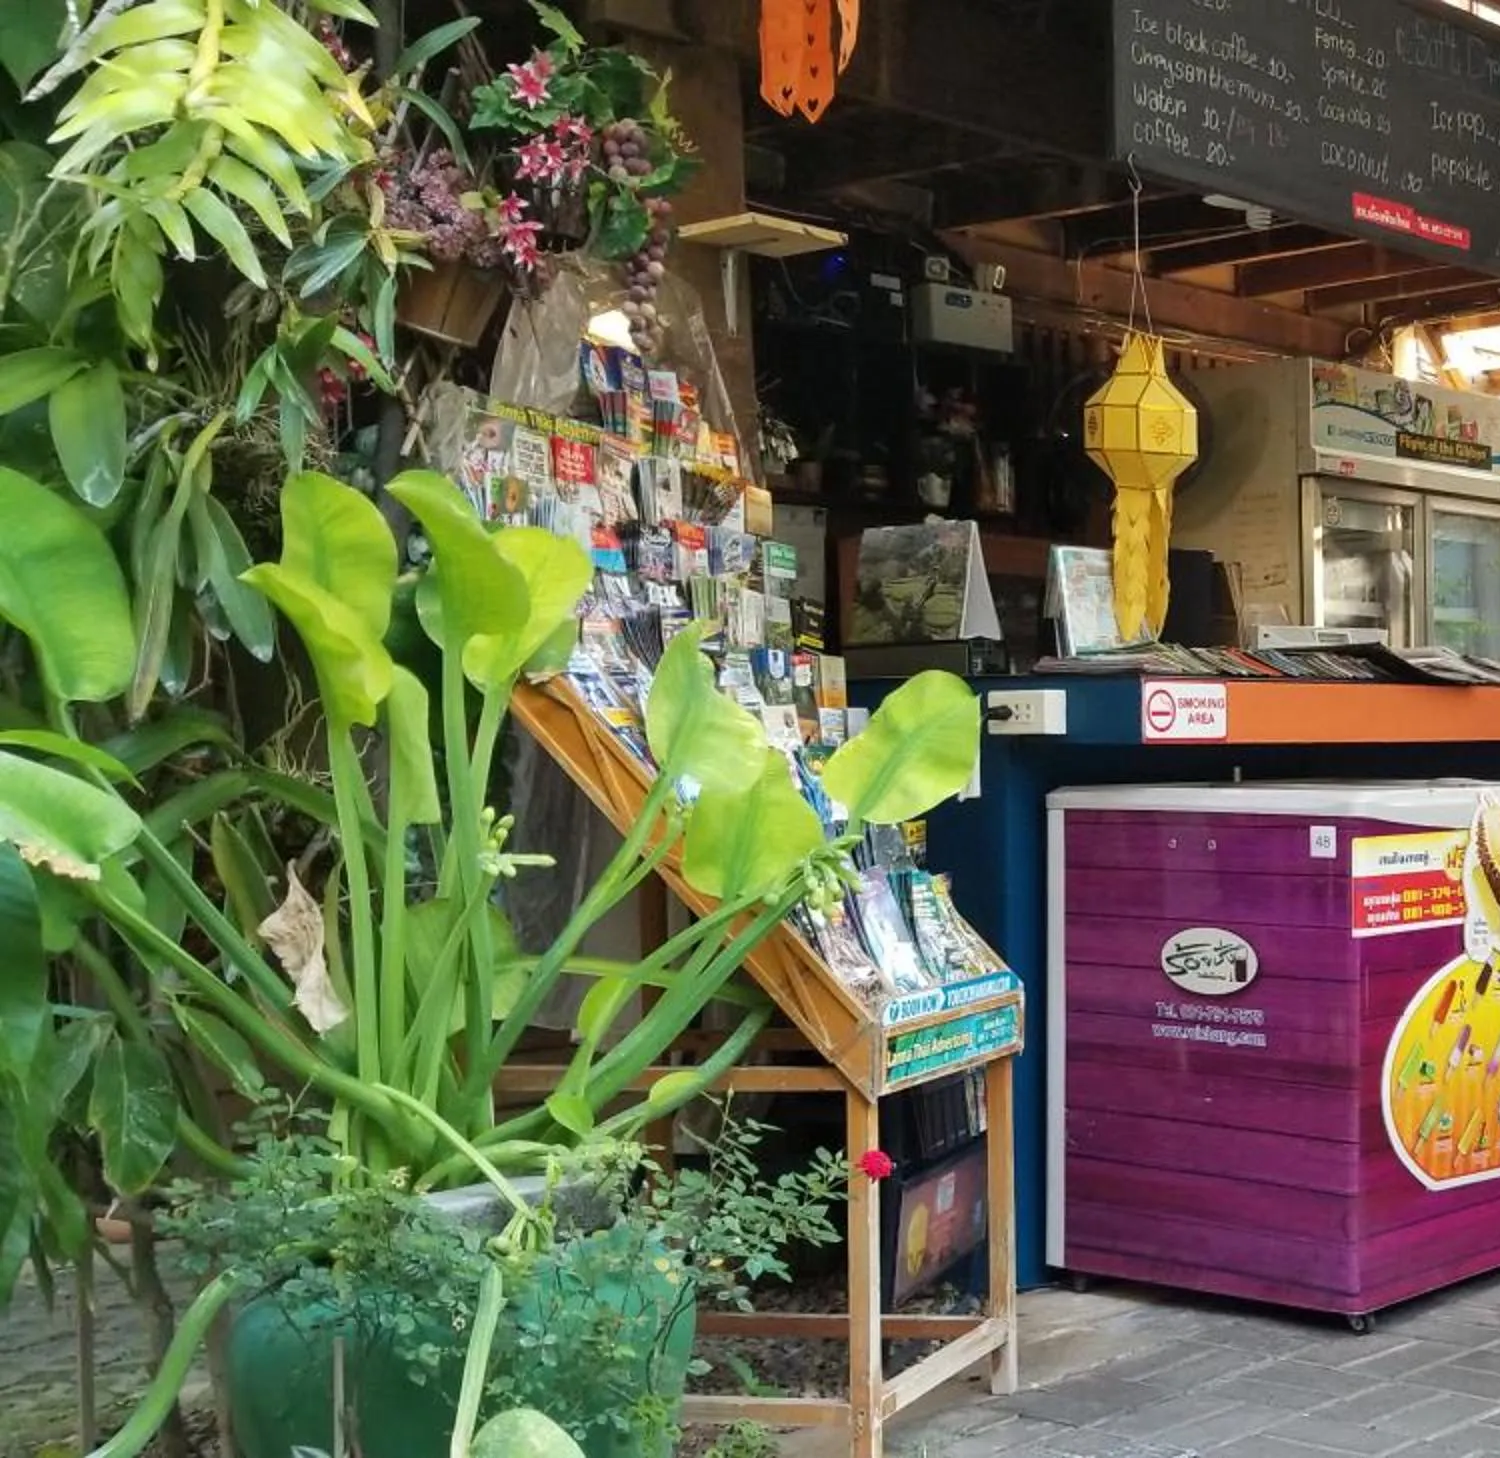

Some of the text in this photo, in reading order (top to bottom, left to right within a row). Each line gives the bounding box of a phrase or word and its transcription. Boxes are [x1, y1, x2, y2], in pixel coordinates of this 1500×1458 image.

[1131, 9, 1159, 35] Ice
[1165, 20, 1208, 55] black
[1211, 32, 1257, 65] coffee
[1132, 83, 1187, 118] Water
[1178, 696, 1226, 710] SMOKING
[1188, 712, 1216, 726] AREA
